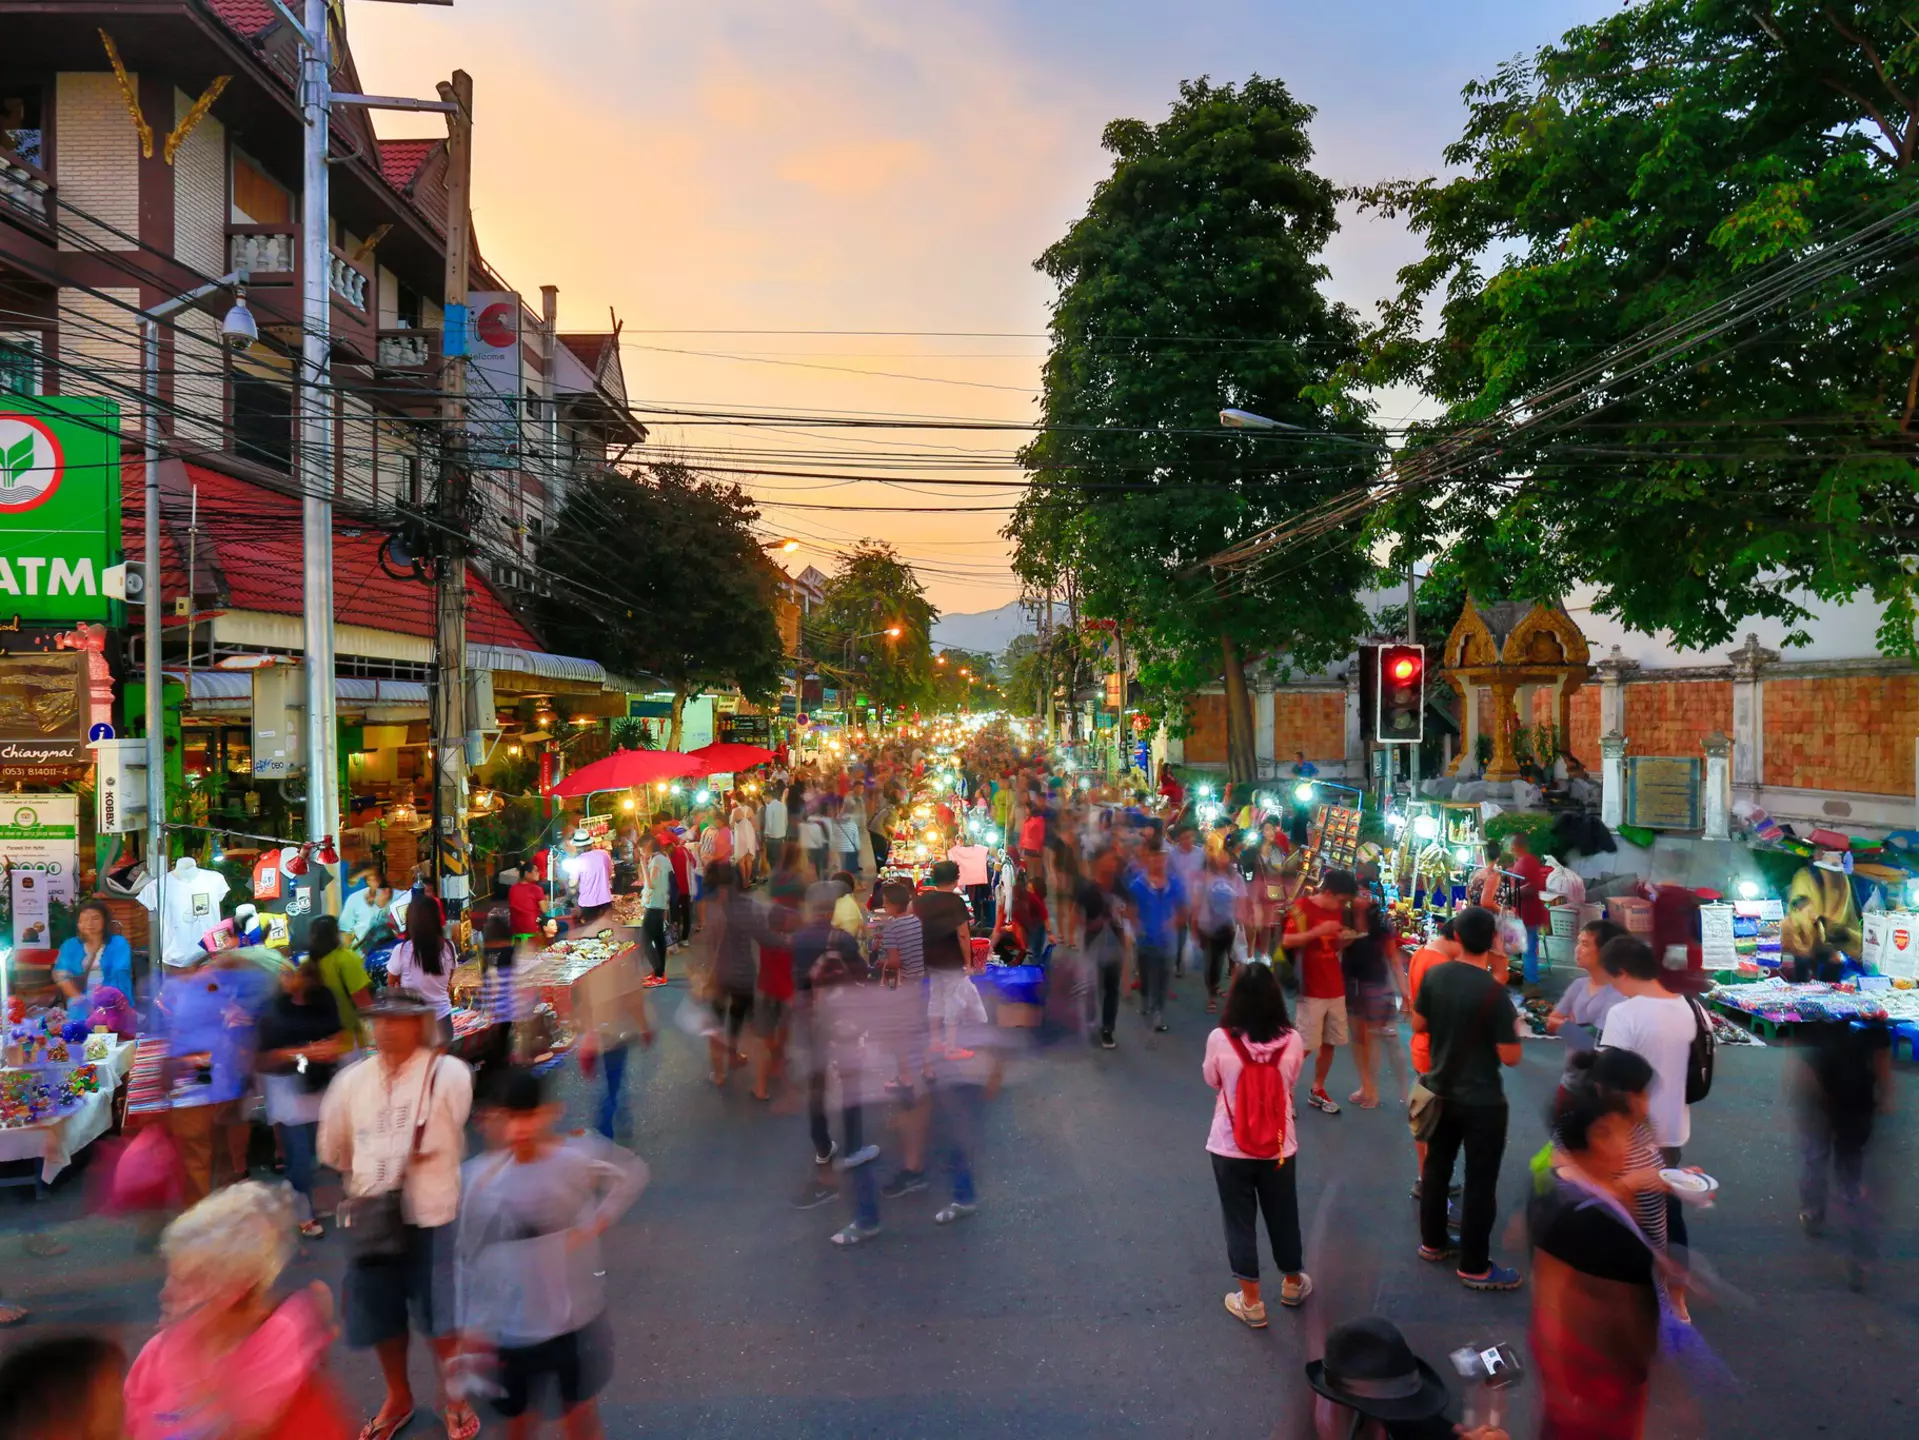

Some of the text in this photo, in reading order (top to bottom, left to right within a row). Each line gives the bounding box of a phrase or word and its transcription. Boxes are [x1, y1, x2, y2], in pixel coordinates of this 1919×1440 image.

[0, 556, 97, 596] ATM
[1, 744, 75, 763] Chiangmai
[2, 767, 25, 776] (053)
